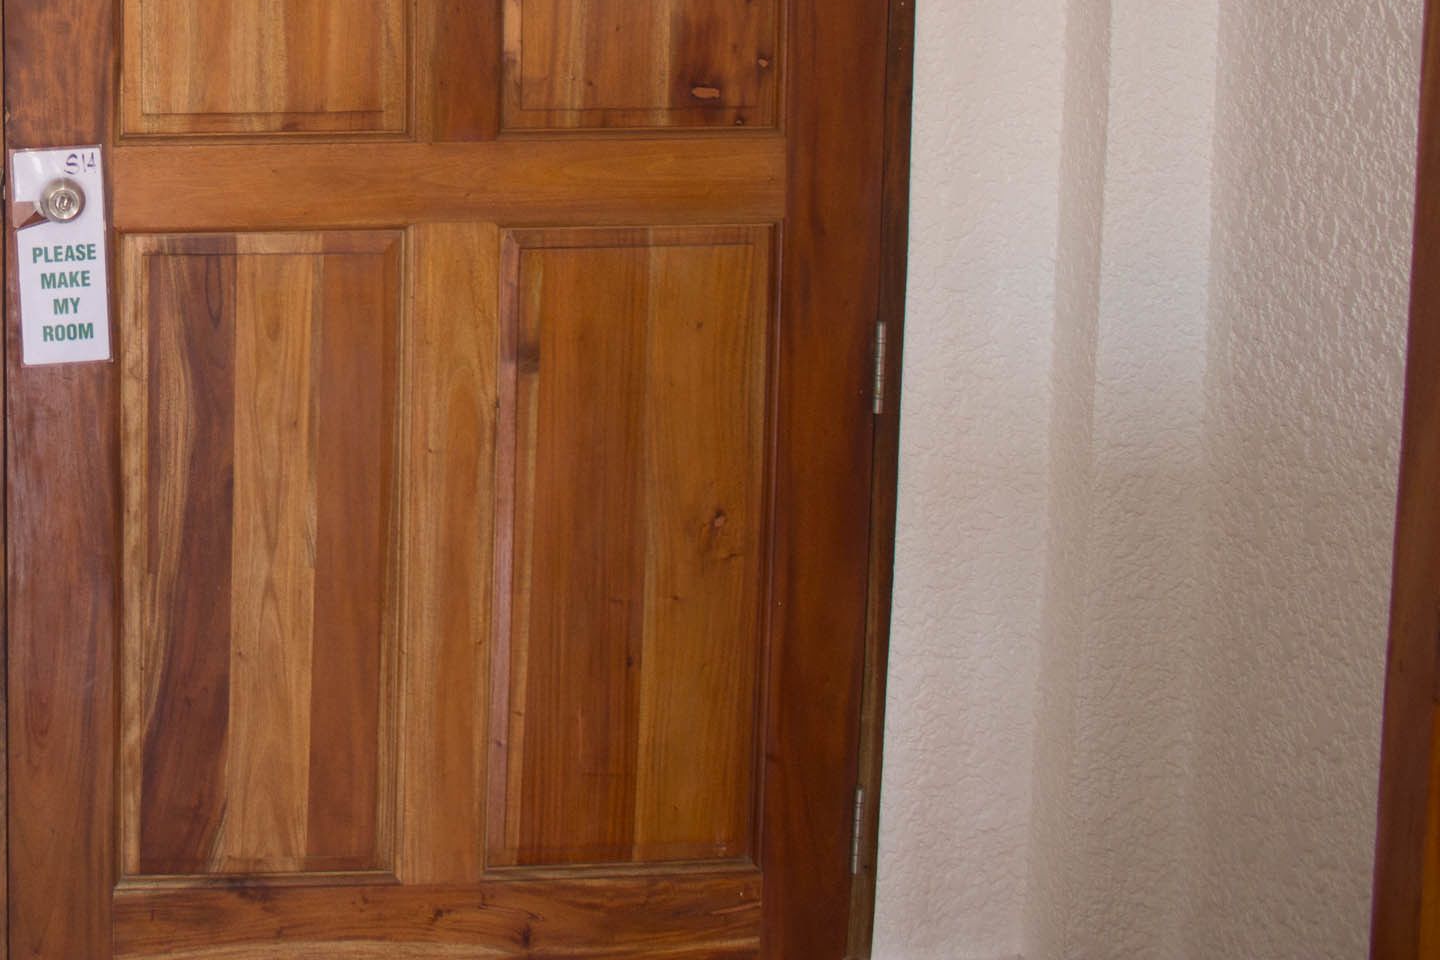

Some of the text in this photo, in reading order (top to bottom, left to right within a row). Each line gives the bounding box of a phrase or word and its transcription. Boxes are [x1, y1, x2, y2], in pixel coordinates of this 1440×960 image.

[32, 244, 97, 264] PLEASE
[40, 270, 91, 289] MAKE
[53, 297, 80, 315] MY
[42, 322, 94, 343] ROOM
